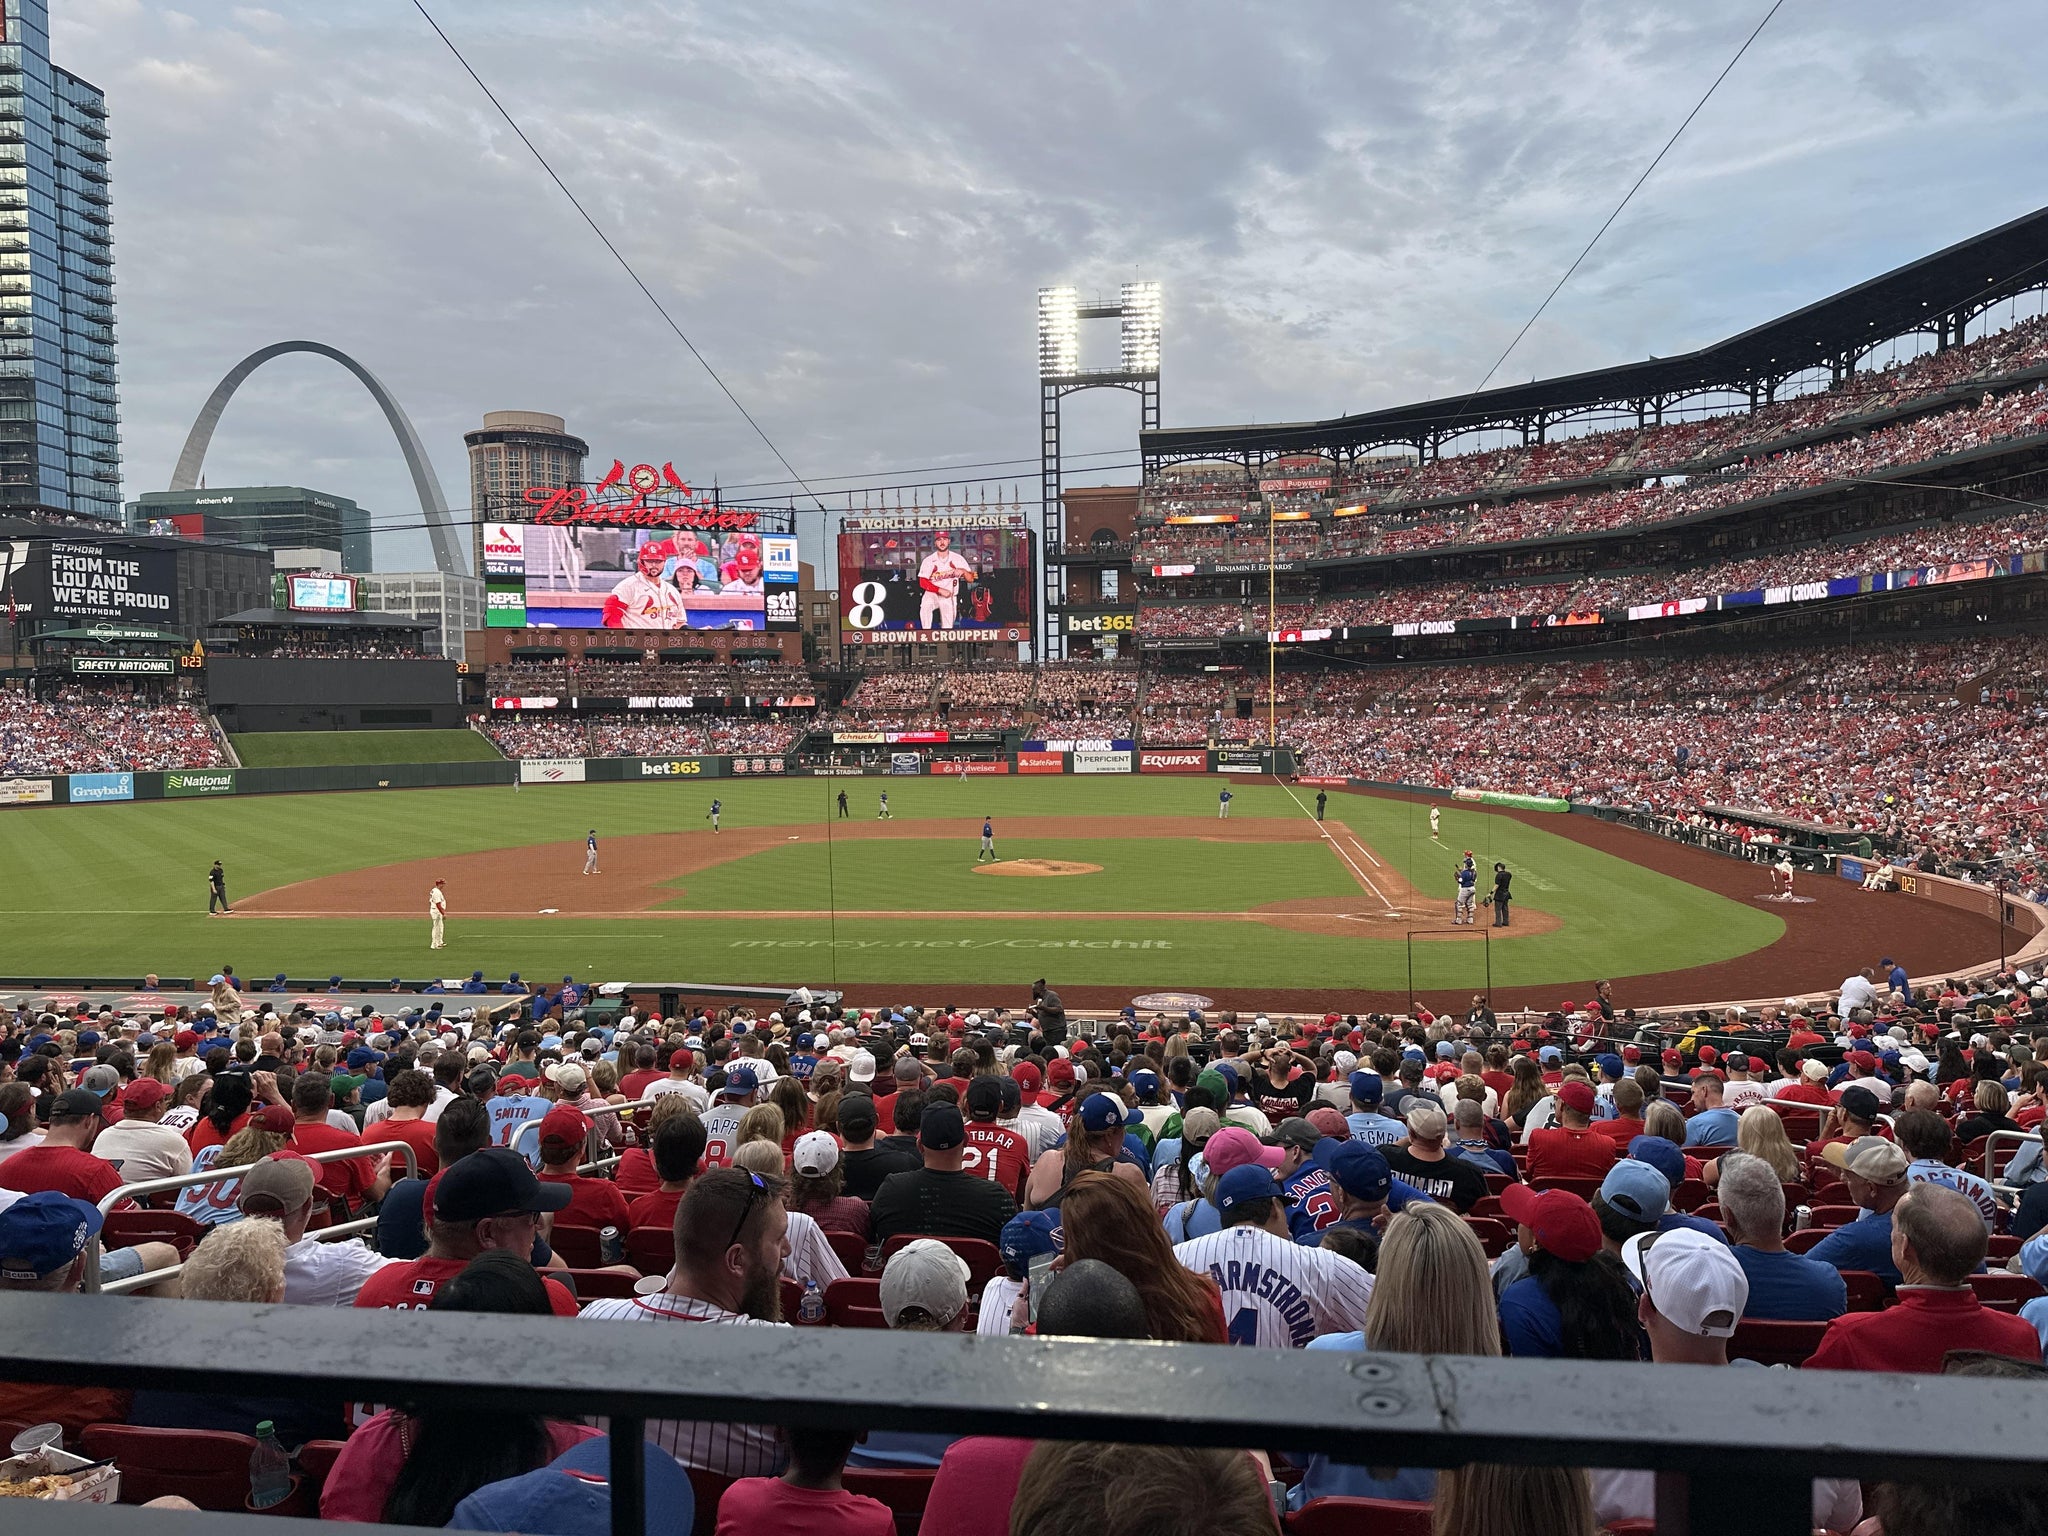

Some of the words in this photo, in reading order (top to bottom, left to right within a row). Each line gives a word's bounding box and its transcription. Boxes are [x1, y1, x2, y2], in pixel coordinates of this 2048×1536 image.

[524, 487, 761, 529] Budweiser
[859, 518, 915, 530] WORLD
[918, 515, 1010, 528] CHAMPIONS
[485, 544, 522, 554] KMOX
[52, 555, 103, 573] FROM
[106, 560, 140, 576] THE
[52, 571, 87, 588] LOU
[91, 574, 128, 590] AND
[1927, 567, 1936, 584] 8
[488, 592, 524, 604] REPEL
[1764, 587, 1792, 605] JIMMY
[1792, 580, 1828, 603] CROOKS
[114, 592, 170, 610] PROUD
[766, 591, 797, 610] stl
[848, 581, 887, 628] 8
[1392, 622, 1419, 636] JIMMY
[1420, 620, 1456, 634] CROOKS
[527, 634, 532, 646] 1
[539, 635, 548, 646] 2
[554, 635, 562, 646] 6
[570, 635, 578, 646] 9
[586, 636, 598, 646] 10
[605, 636, 618, 646] 14
[625, 636, 637, 647] 17
[644, 636, 660, 647] 20
[668, 637, 684, 648] 23
[690, 637, 704, 648] 24
[711, 637, 726, 648] 42
[872, 632, 917, 642] BROWN
[920, 633, 928, 641] &
[932, 630, 998, 641] CROUPPEN
[78, 660, 116, 670] SAFETY
[118, 661, 168, 671] NATIONAL
[628, 696, 656, 708] JIMMY
[658, 696, 694, 708] CROOKS
[776, 696, 784, 706] 8
[1046, 740, 1075, 752] JIMMY
[1076, 739, 1112, 751] CROOKS
[642, 762, 700, 775] bet365
[1142, 755, 1202, 768] EQUIFAX
[183, 775, 232, 787] National
[495, 1107, 530, 1121] SMITH
[502, 1122, 512, 1145] 1
[962, 1146, 998, 1182] 21
[1306, 1191, 1342, 1232] 2
